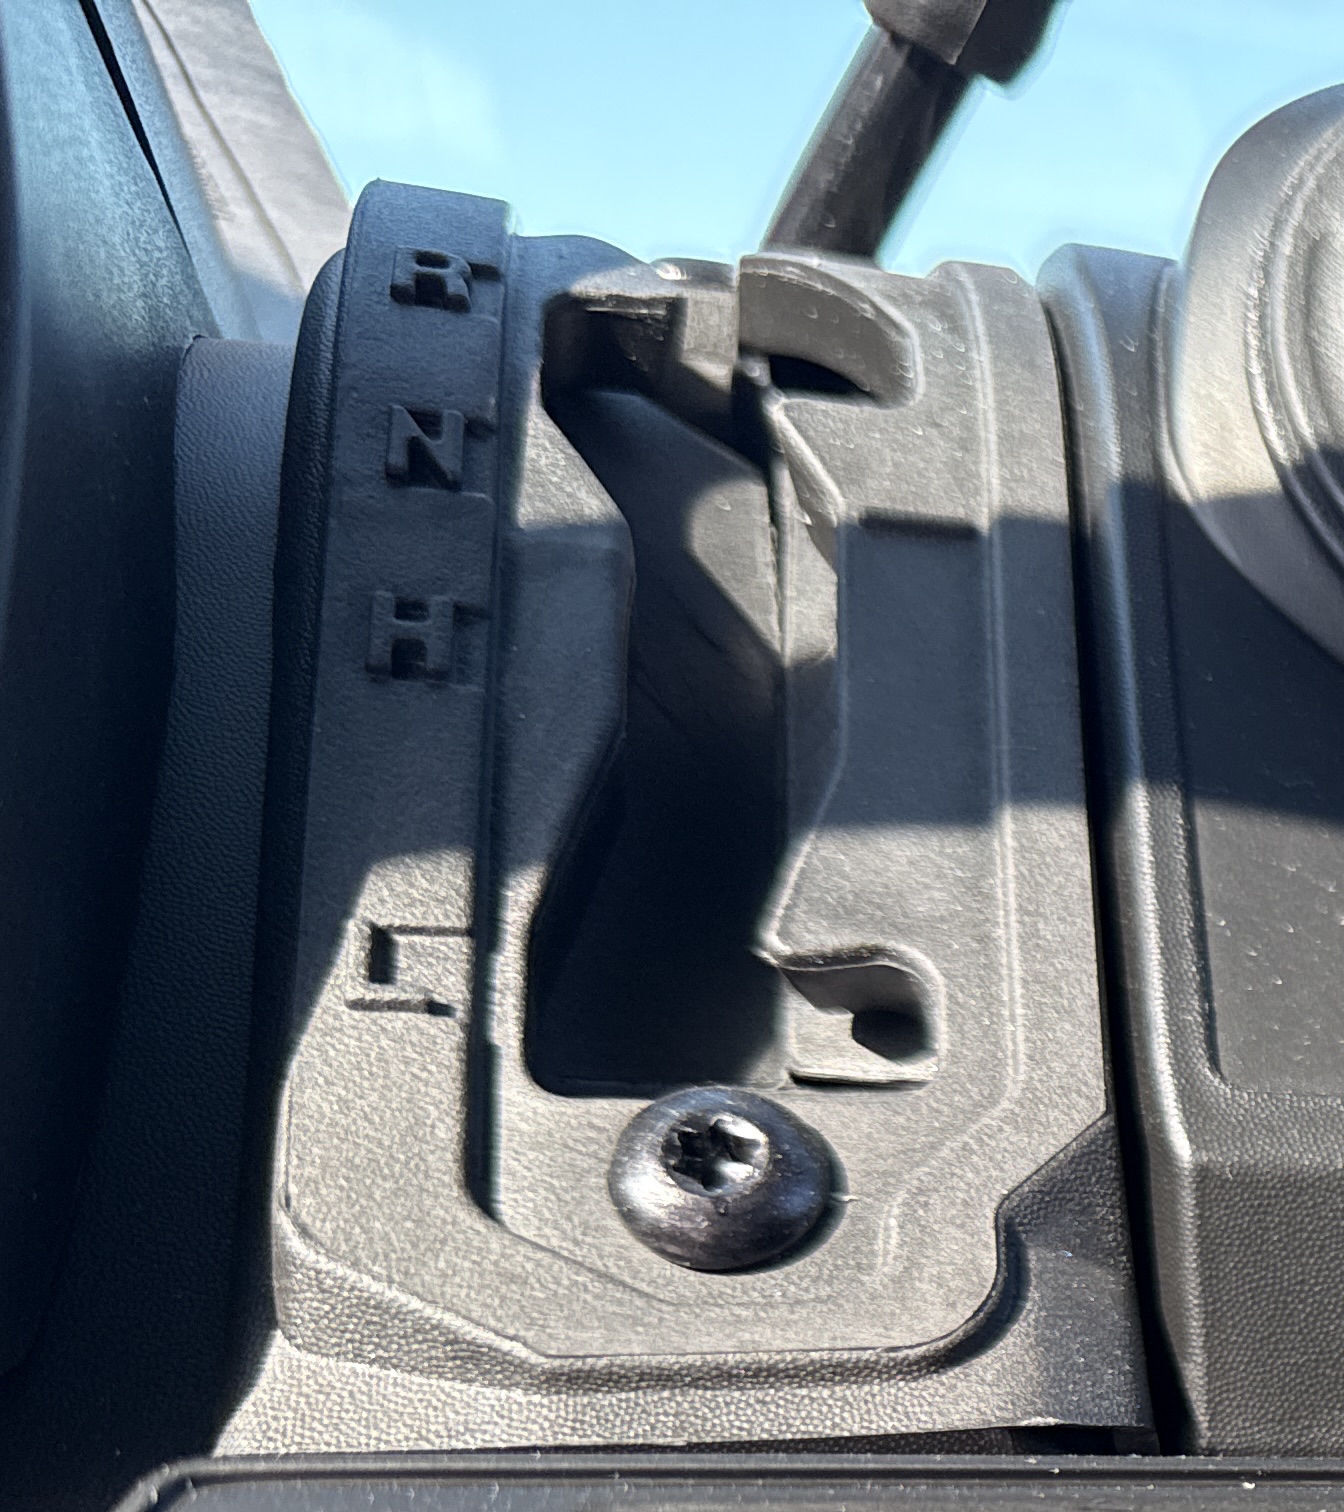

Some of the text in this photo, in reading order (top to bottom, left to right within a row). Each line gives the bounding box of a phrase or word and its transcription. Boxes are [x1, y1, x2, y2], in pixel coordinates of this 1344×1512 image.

[391, 246, 474, 312] R
[384, 405, 466, 488] N
[365, 589, 454, 679] H
